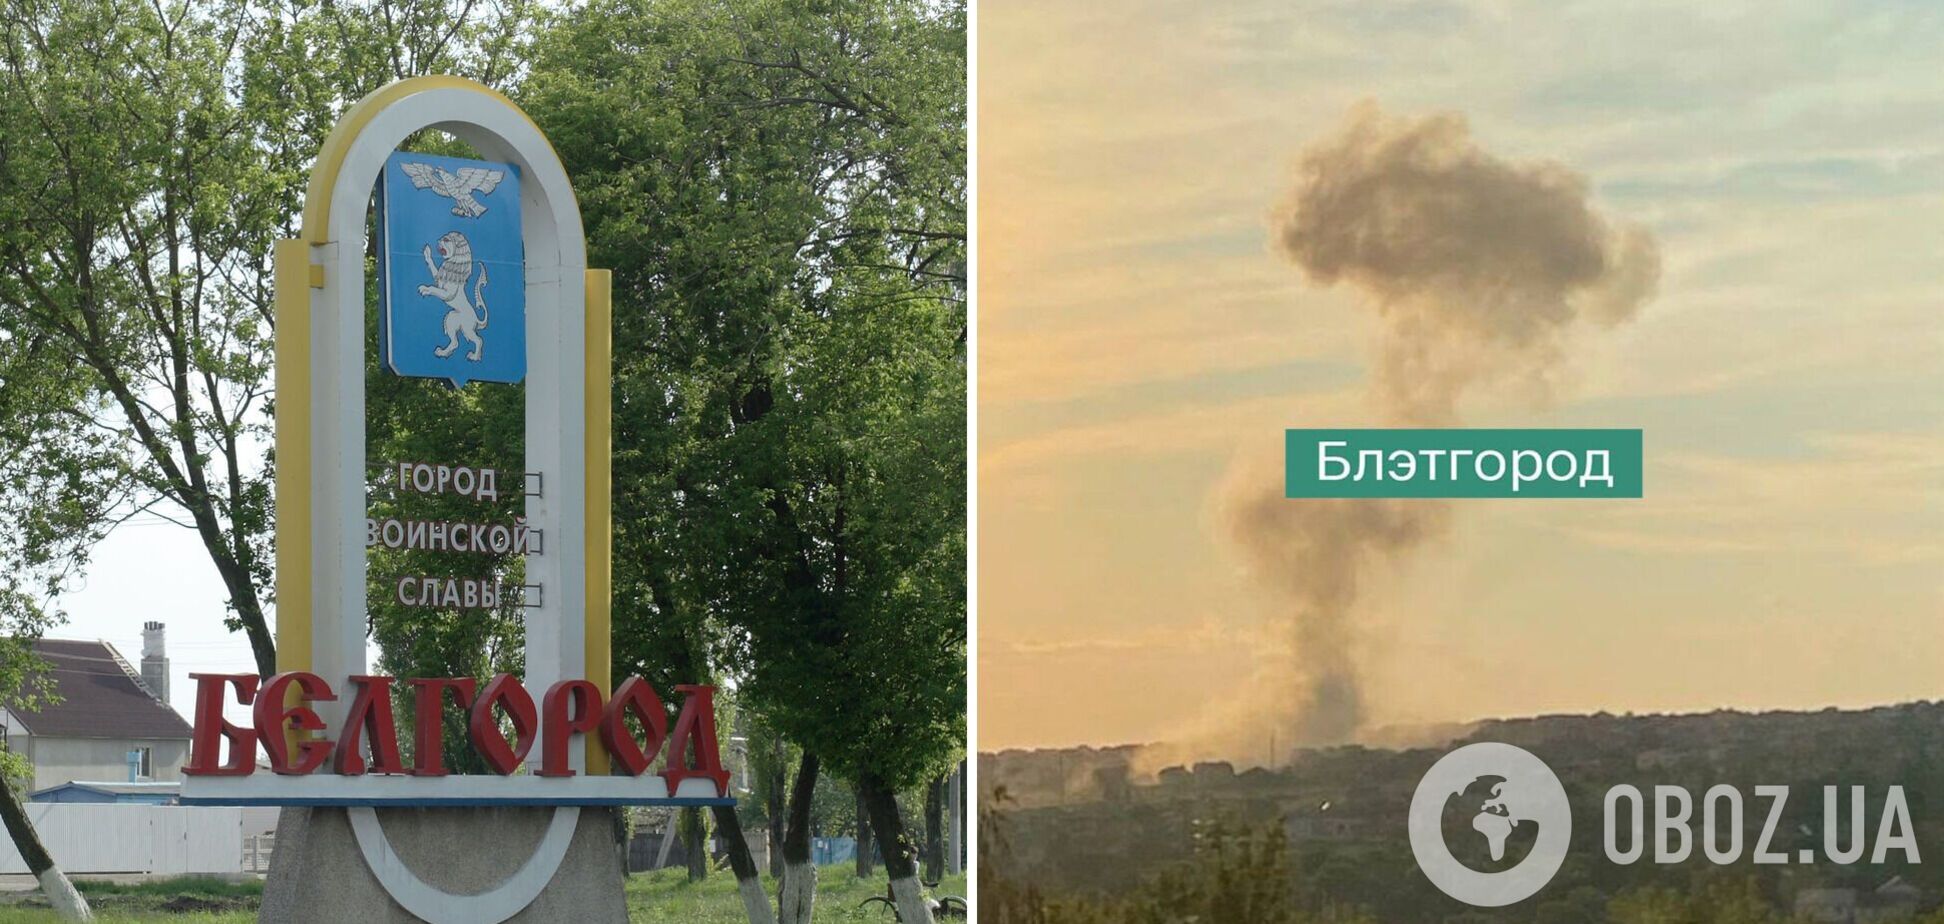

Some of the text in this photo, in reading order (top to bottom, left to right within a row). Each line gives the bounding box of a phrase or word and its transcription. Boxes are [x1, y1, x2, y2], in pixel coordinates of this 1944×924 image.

[399, 462, 498, 501] ГОРОД
[366, 516, 531, 555] ВОИНСКОЙ
[398, 576, 501, 608] СЛАВЫ
